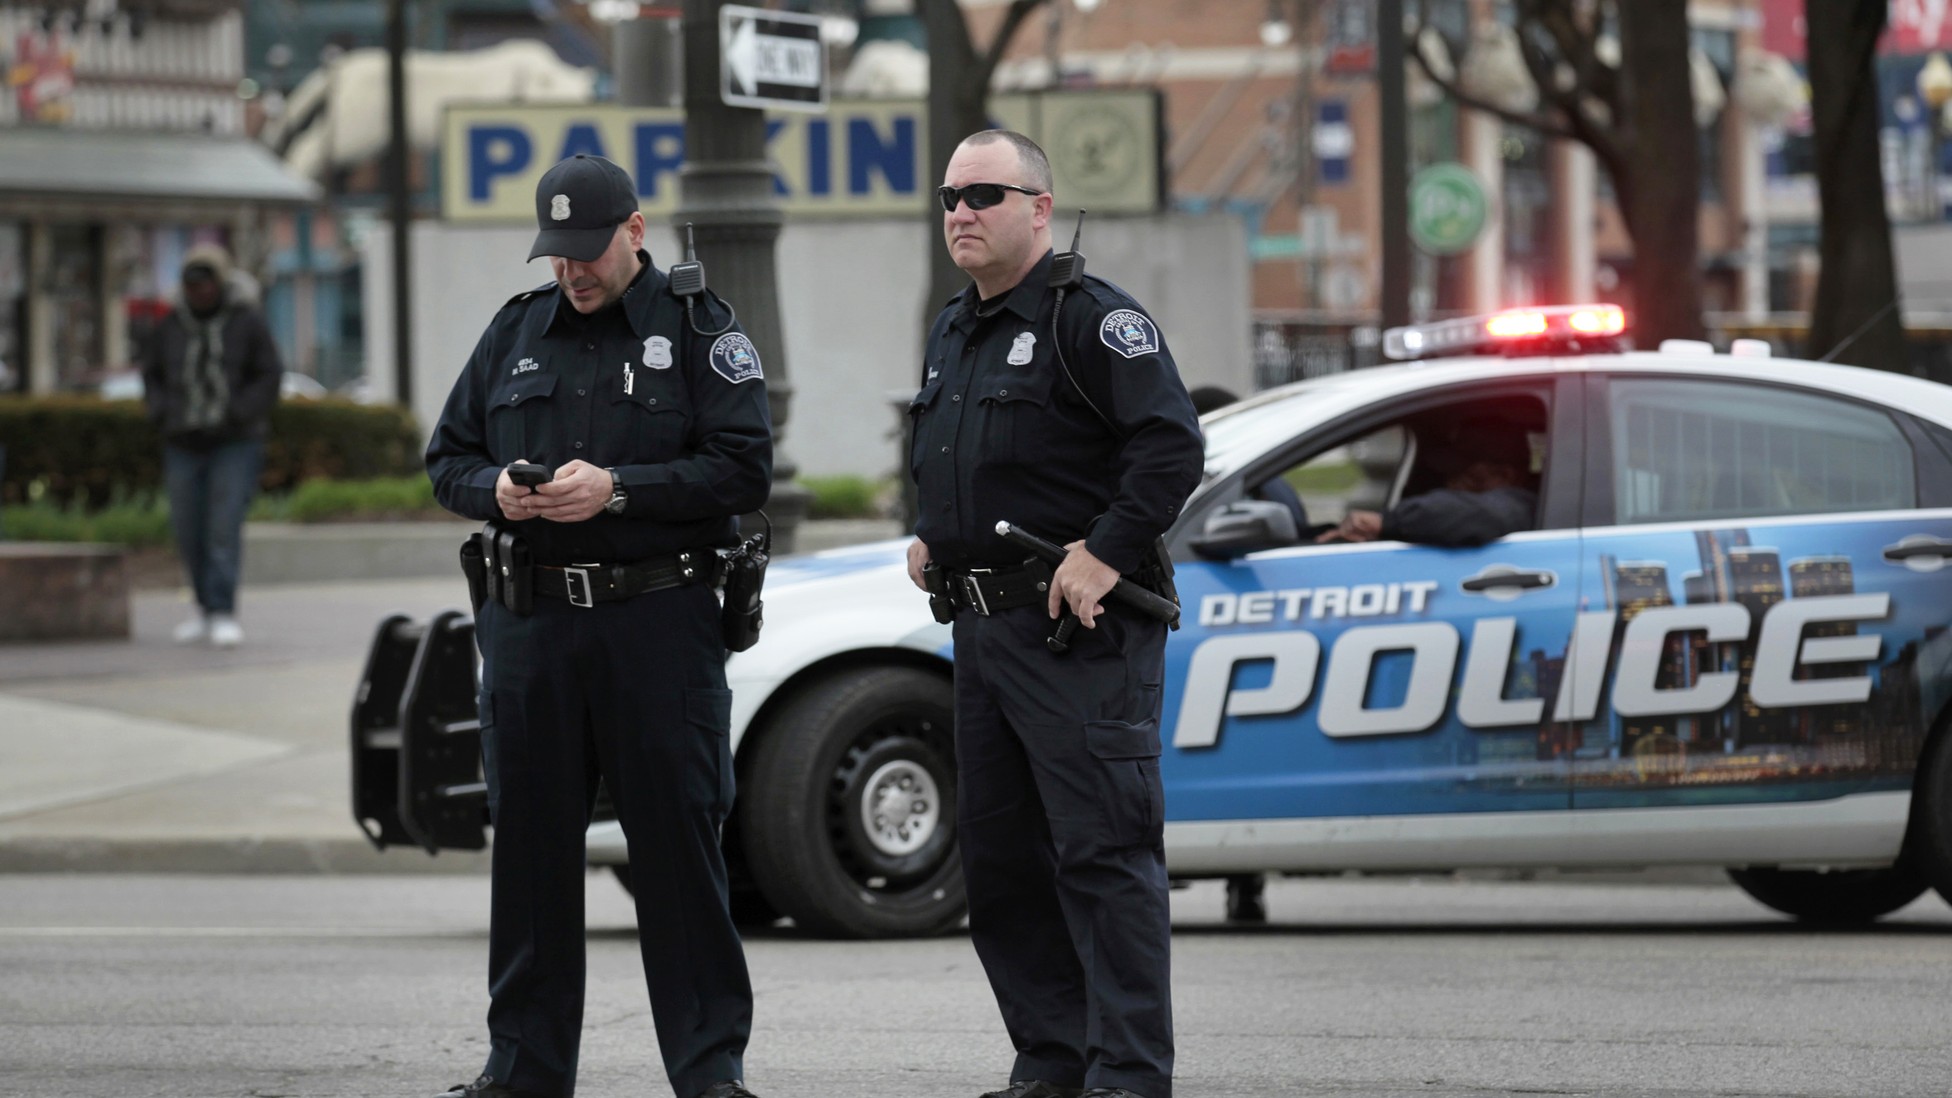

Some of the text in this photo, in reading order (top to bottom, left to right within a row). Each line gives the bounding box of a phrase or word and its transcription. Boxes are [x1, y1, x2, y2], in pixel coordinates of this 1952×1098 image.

[1104, 312, 1146, 333] DETROIT
[1126, 344, 1155, 355] POLICE
[518, 362, 540, 373] SAAD
[1198, 579, 1439, 627] DETROIT
[1171, 591, 1892, 749] POLICE
